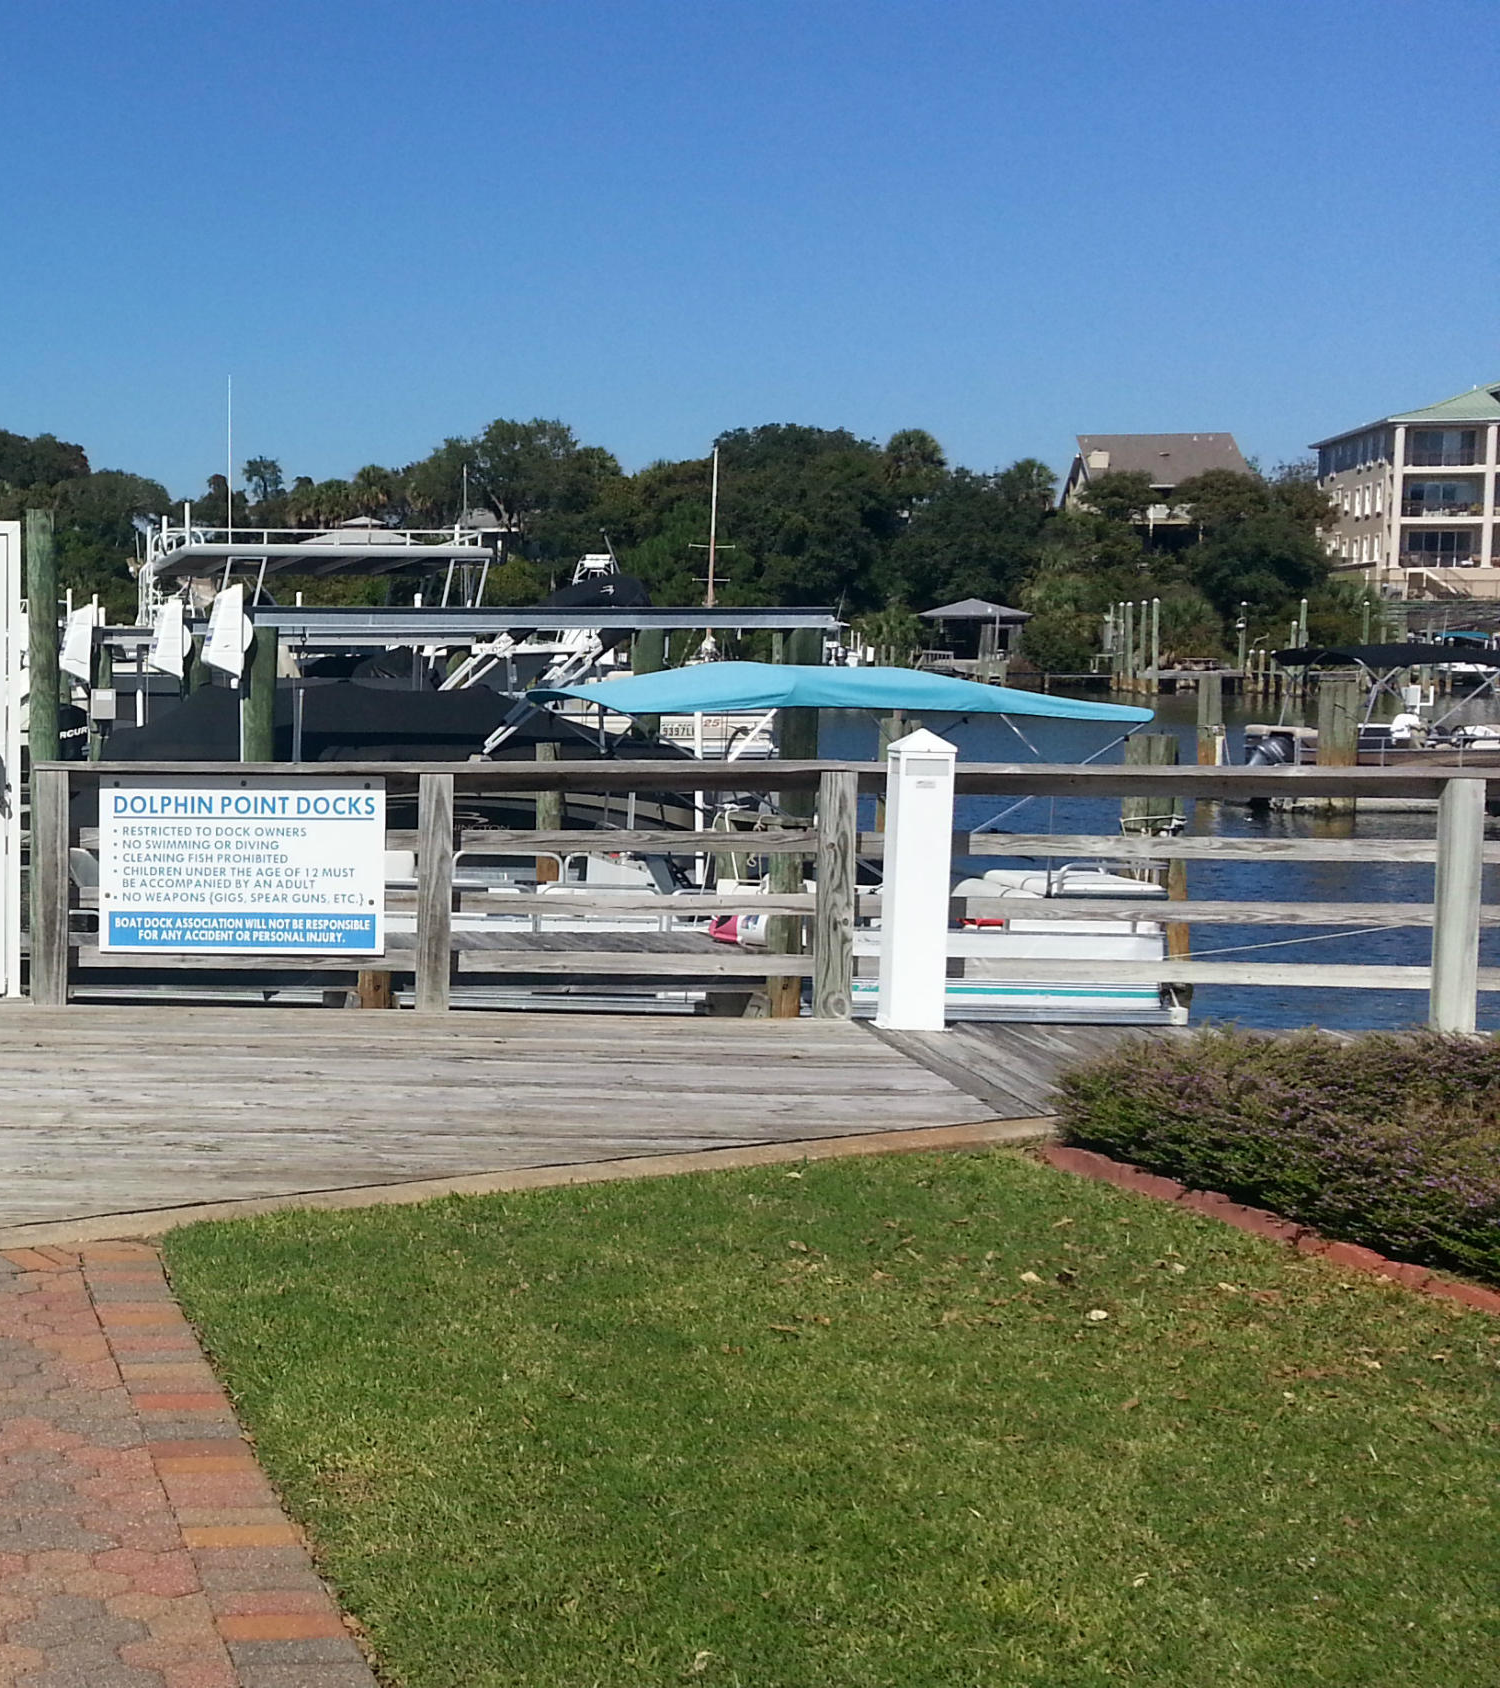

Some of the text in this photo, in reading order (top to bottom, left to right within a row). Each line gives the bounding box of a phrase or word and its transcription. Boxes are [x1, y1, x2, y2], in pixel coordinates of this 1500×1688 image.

[703, 719, 721, 728] 25
[59, 726, 89, 740] RCUR
[114, 796, 375, 815] DOLPHIN POINT DOCKS
[123, 827, 306, 837] RESTRICTED TO DOCK OWNERS
[123, 840, 279, 850] NO SWIMMING OR DIVING
[123, 854, 288, 863] CLEANING FISH PROHIBITED
[123, 867, 355, 878] CHILDREN UNDER THE AGE OF 12 MUST
[123, 879, 314, 889] BE ACCOMPANIED BY AN ADULT
[123, 893, 142, 902] NO
[145, 893, 206, 902] WEAPONS
[250, 893, 289, 903] SPEAR
[115, 917, 370, 930] BOAT DOCK ASSOCIATION WILL NOT BE RESPONSIBLE
[138, 930, 345, 943] FOR ANY ACCIDENT OR PERSONAL INJURY.
